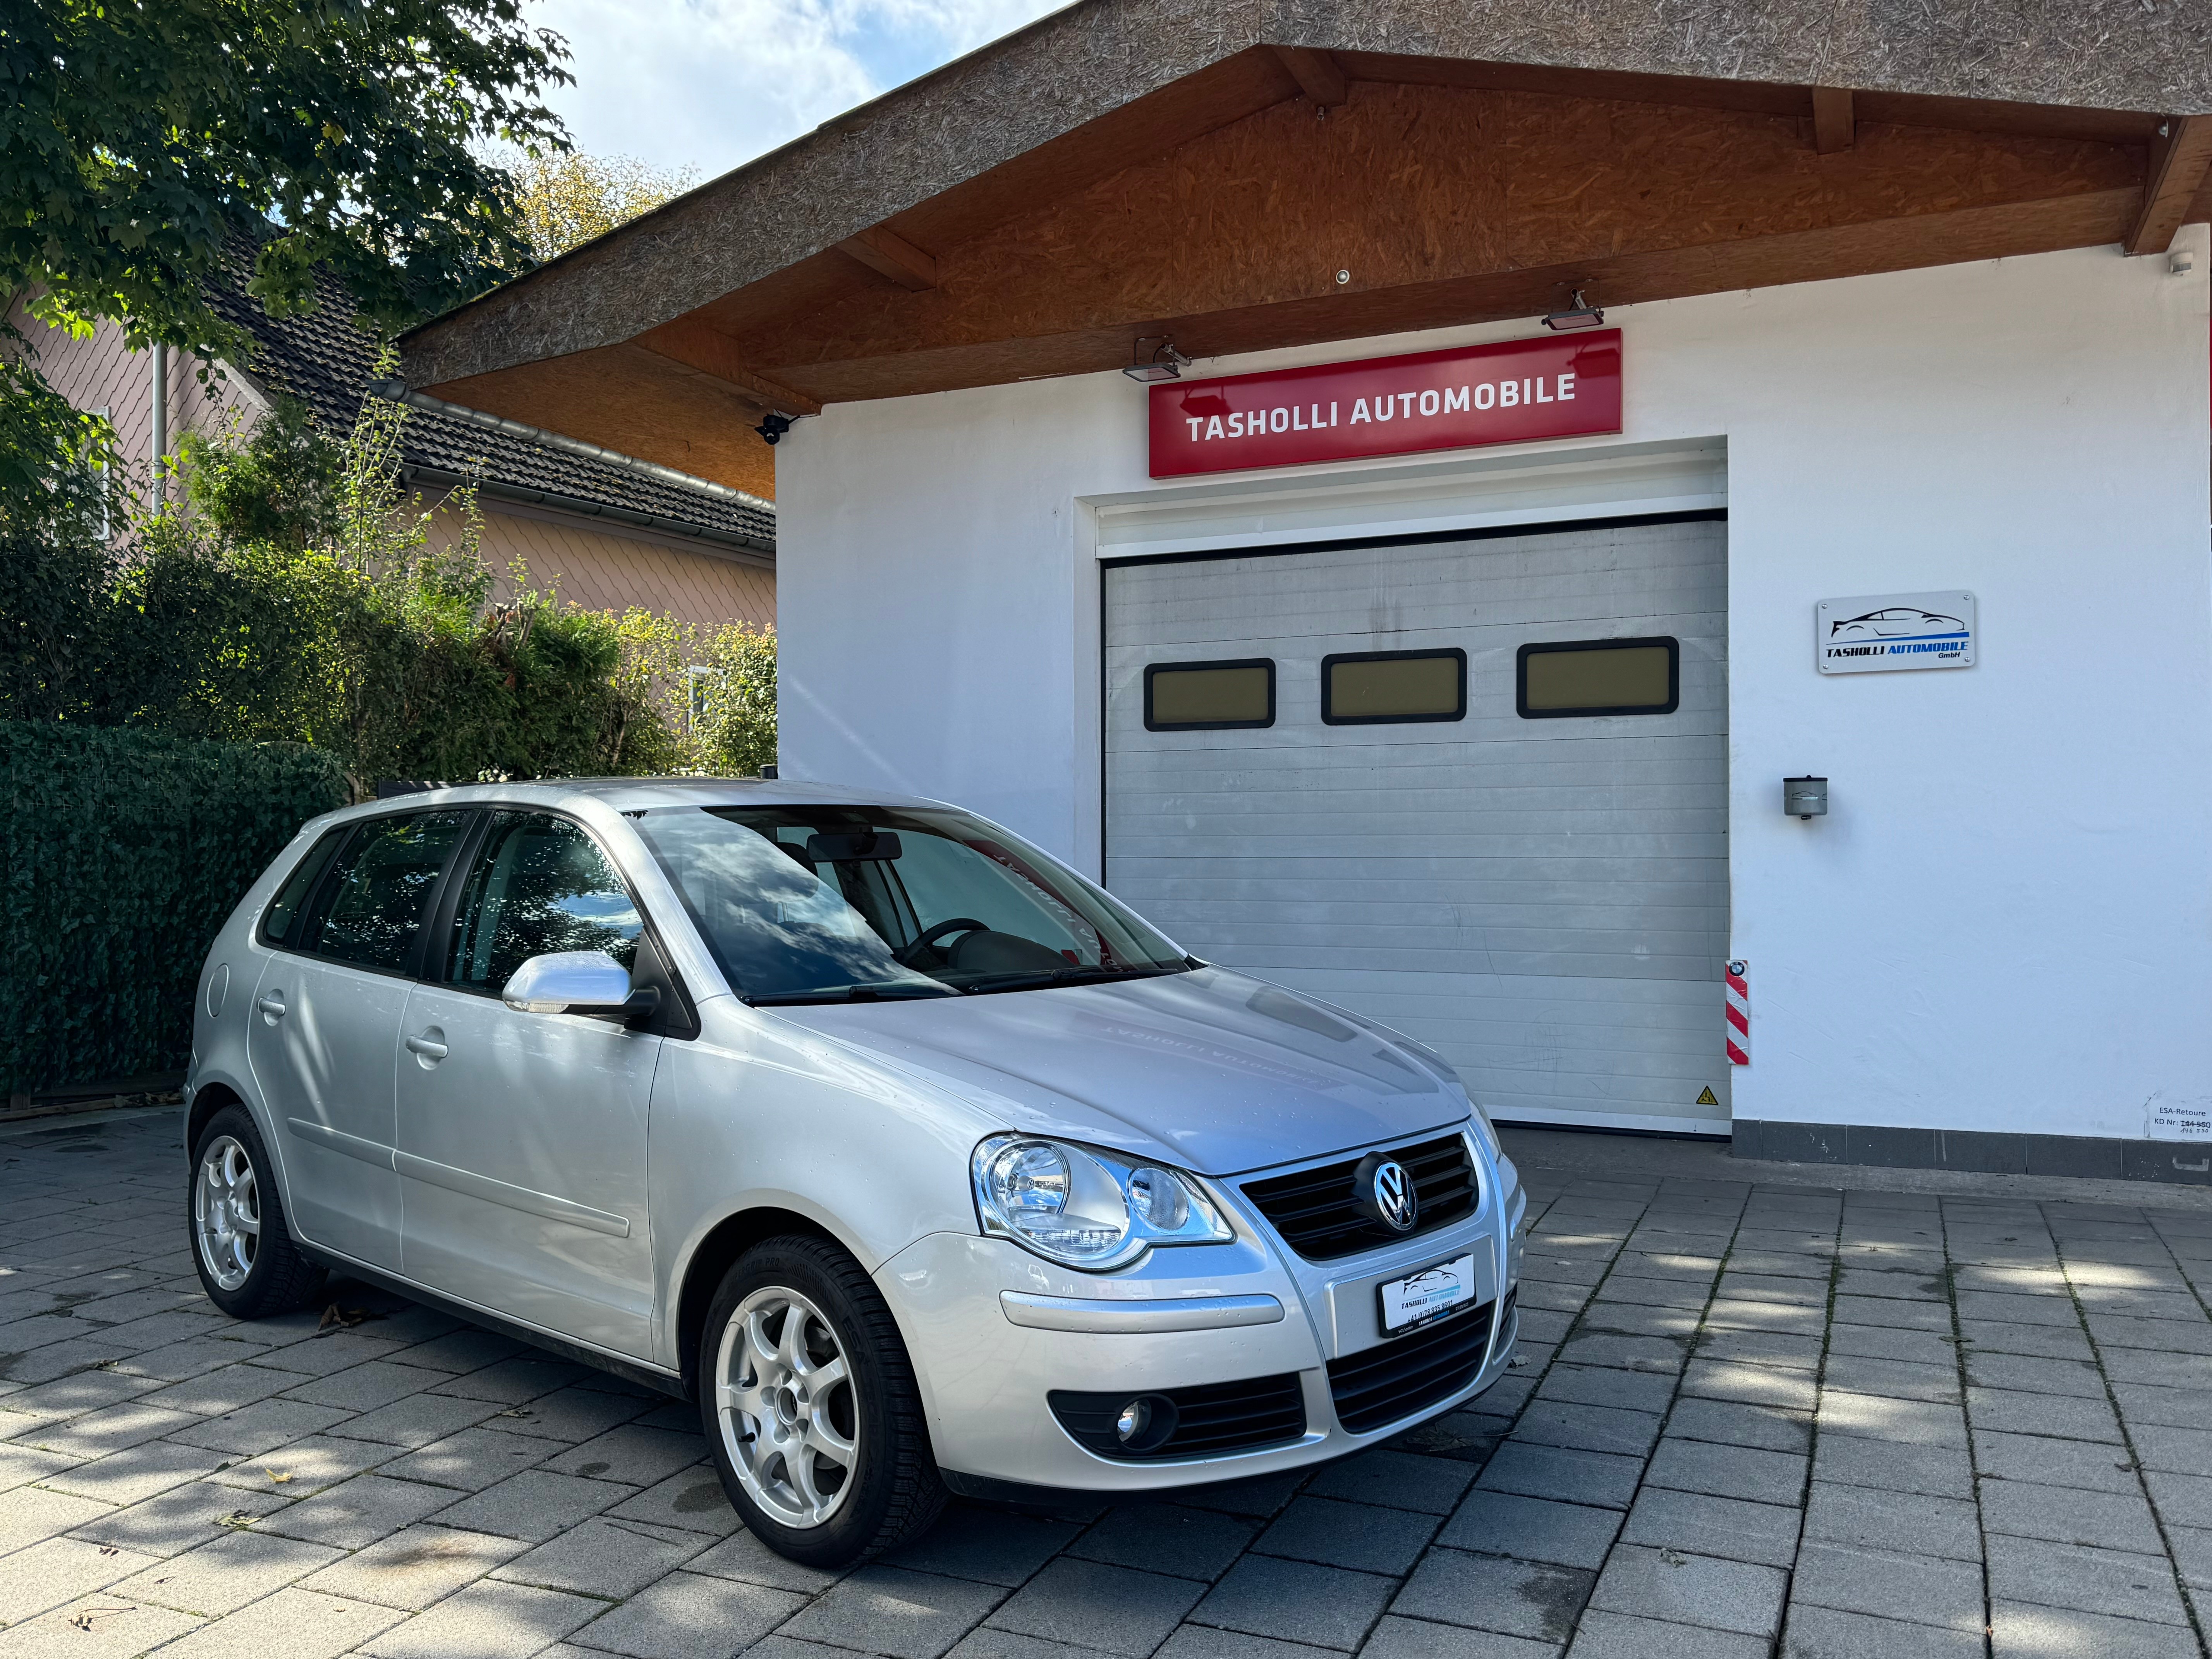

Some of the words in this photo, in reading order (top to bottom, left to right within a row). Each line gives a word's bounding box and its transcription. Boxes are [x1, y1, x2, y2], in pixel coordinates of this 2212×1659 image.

[1186, 400, 1336, 442] TASHOLLI
[1349, 373, 1576, 425] AUTOMOBILE
[1826, 646, 1884, 658] TASHOLLI
[1887, 641, 1969, 654] AUTOMOBILE
[2160, 1107, 2206, 1116] ESA-Retoure
[1402, 1298, 1427, 1309] TASHOLLI
[1429, 1290, 1460, 1302] AUTOMOBILE
